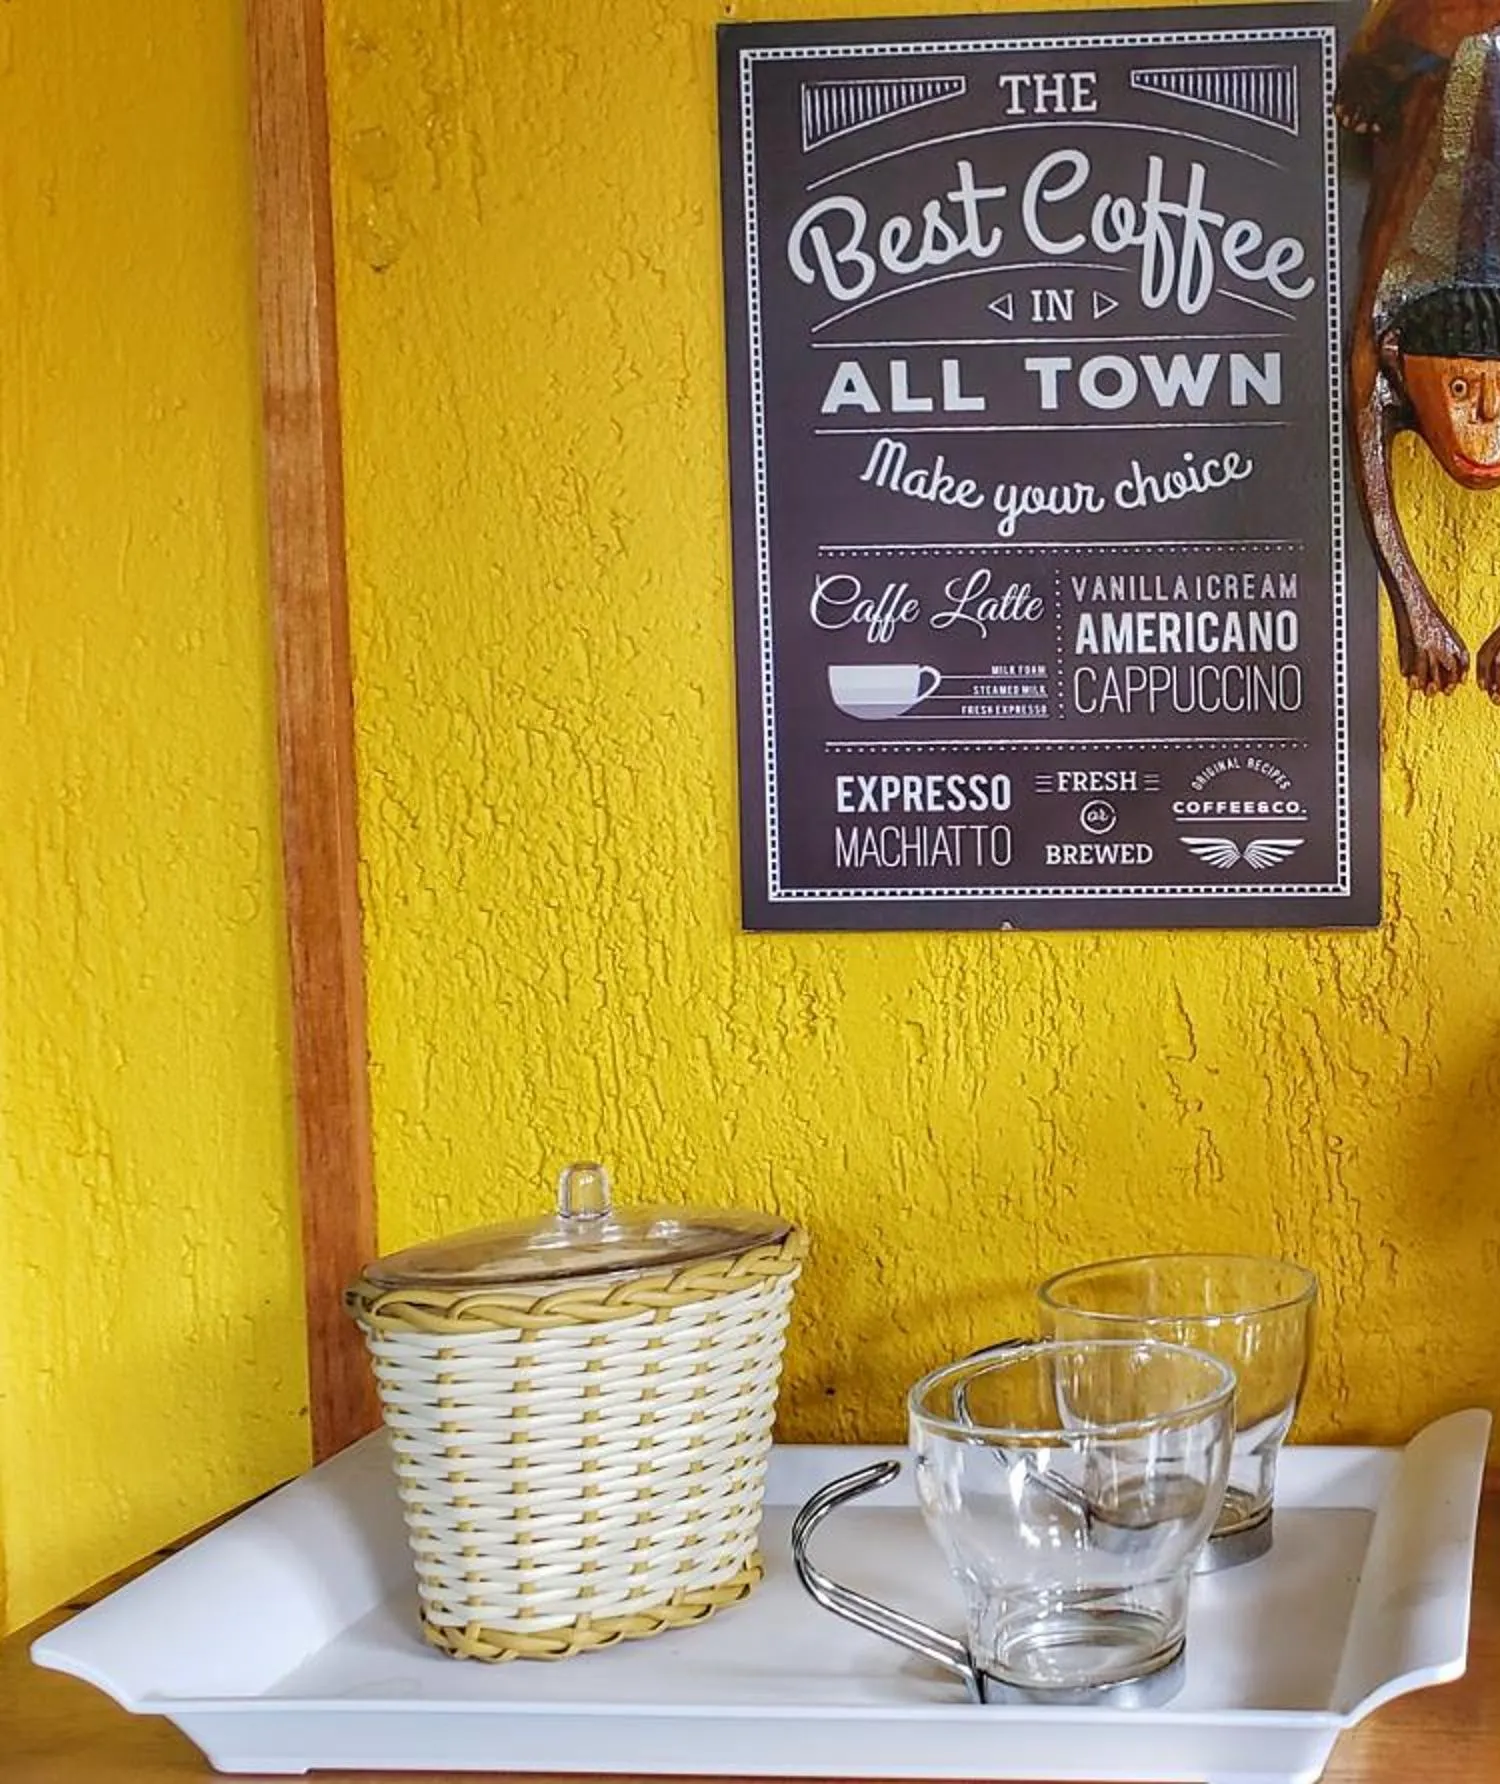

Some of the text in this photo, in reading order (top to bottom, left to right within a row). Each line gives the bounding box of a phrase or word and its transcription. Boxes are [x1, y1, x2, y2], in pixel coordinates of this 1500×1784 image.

[1000, 72, 1097, 115] THE
[787, 149, 1315, 315] Best Coffee
[1032, 290, 1074, 322] IN
[820, 352, 1282, 413] ALL TOWN
[860, 437, 1254, 538] Make your choice
[810, 568, 1045, 643] Caffe Latte
[1075, 610, 1299, 655] AMERICANO
[1073, 664, 1301, 714] CAPPUCCINO
[836, 774, 1011, 812] EXPRESSO
[1057, 771, 1137, 792] FRESH
[1191, 757, 1292, 791] ORIGINAL RECIPES
[1172, 801, 1308, 814] COFFEE&CO.
[835, 825, 1011, 868] MACHIATTO
[1045, 843, 1153, 865] BREWED
